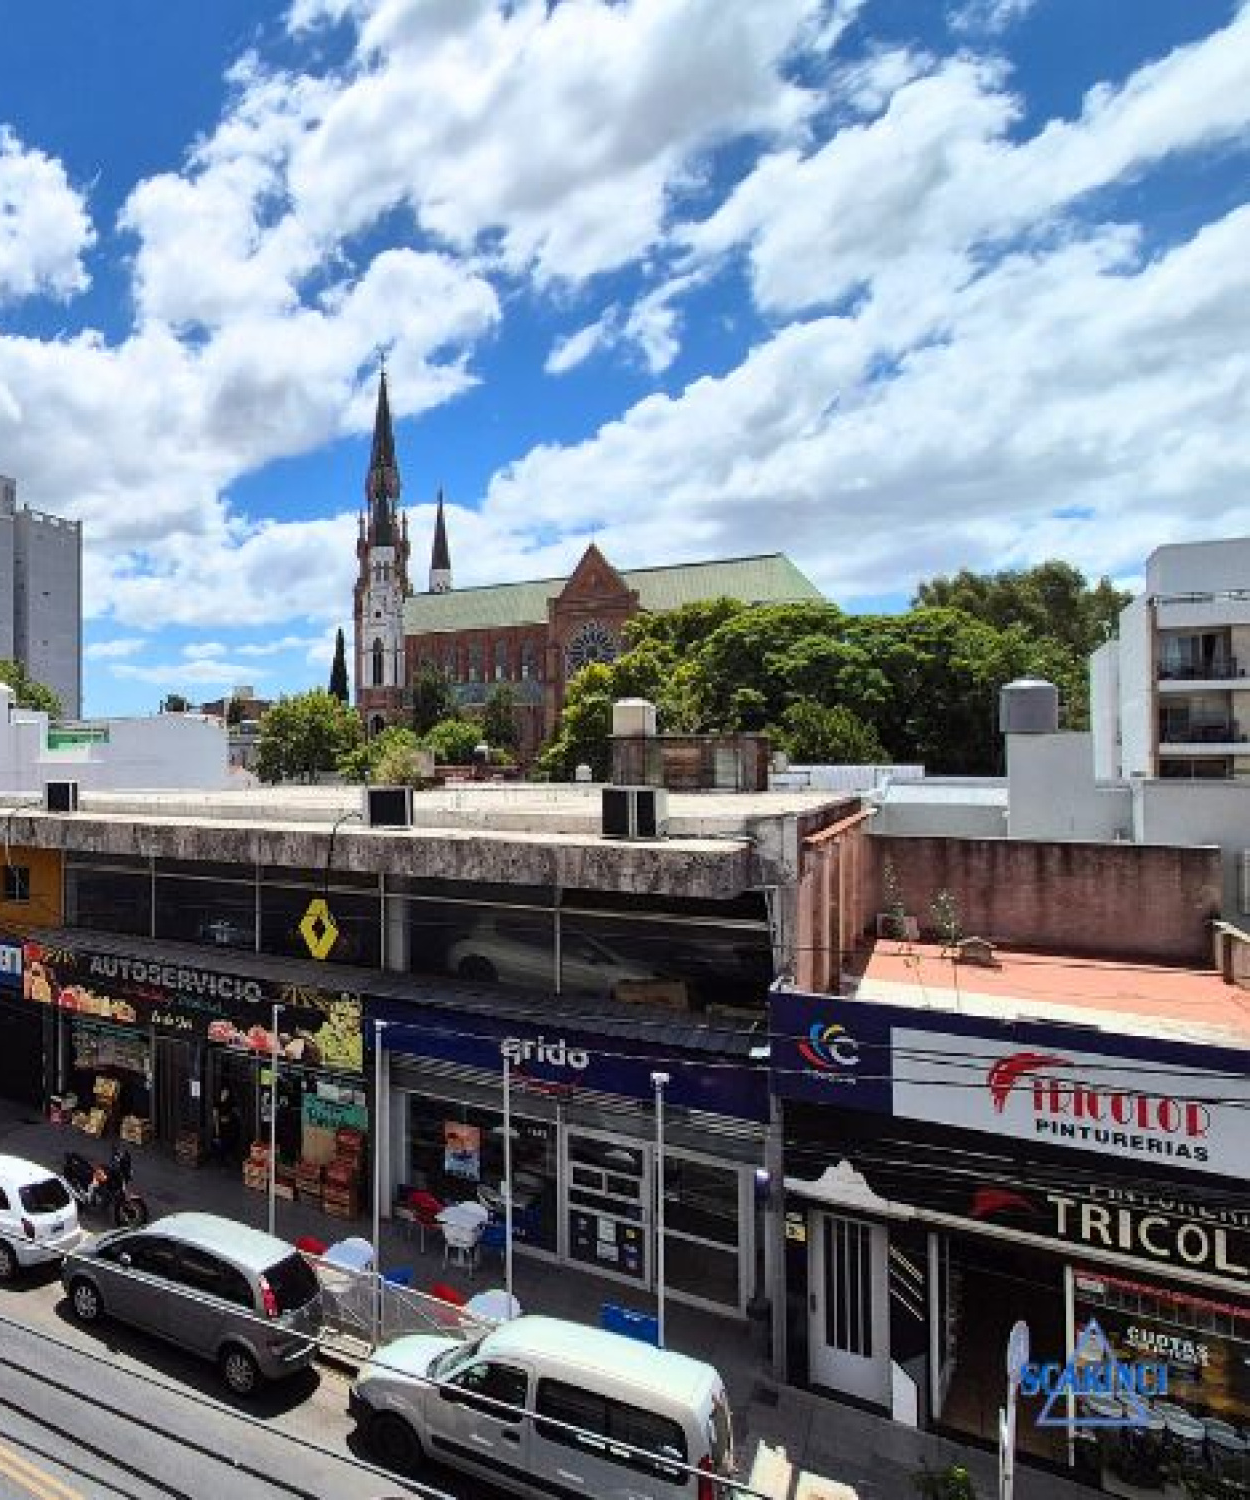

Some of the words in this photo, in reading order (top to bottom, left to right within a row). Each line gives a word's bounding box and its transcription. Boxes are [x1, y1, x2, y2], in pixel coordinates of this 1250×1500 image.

[90, 955, 262, 1002] AUTOSERVICIO
[501, 1036, 589, 1070] grido
[1036, 1118, 1209, 1162] PINTURERIAS
[1047, 1194, 1249, 1276] TRICOL
